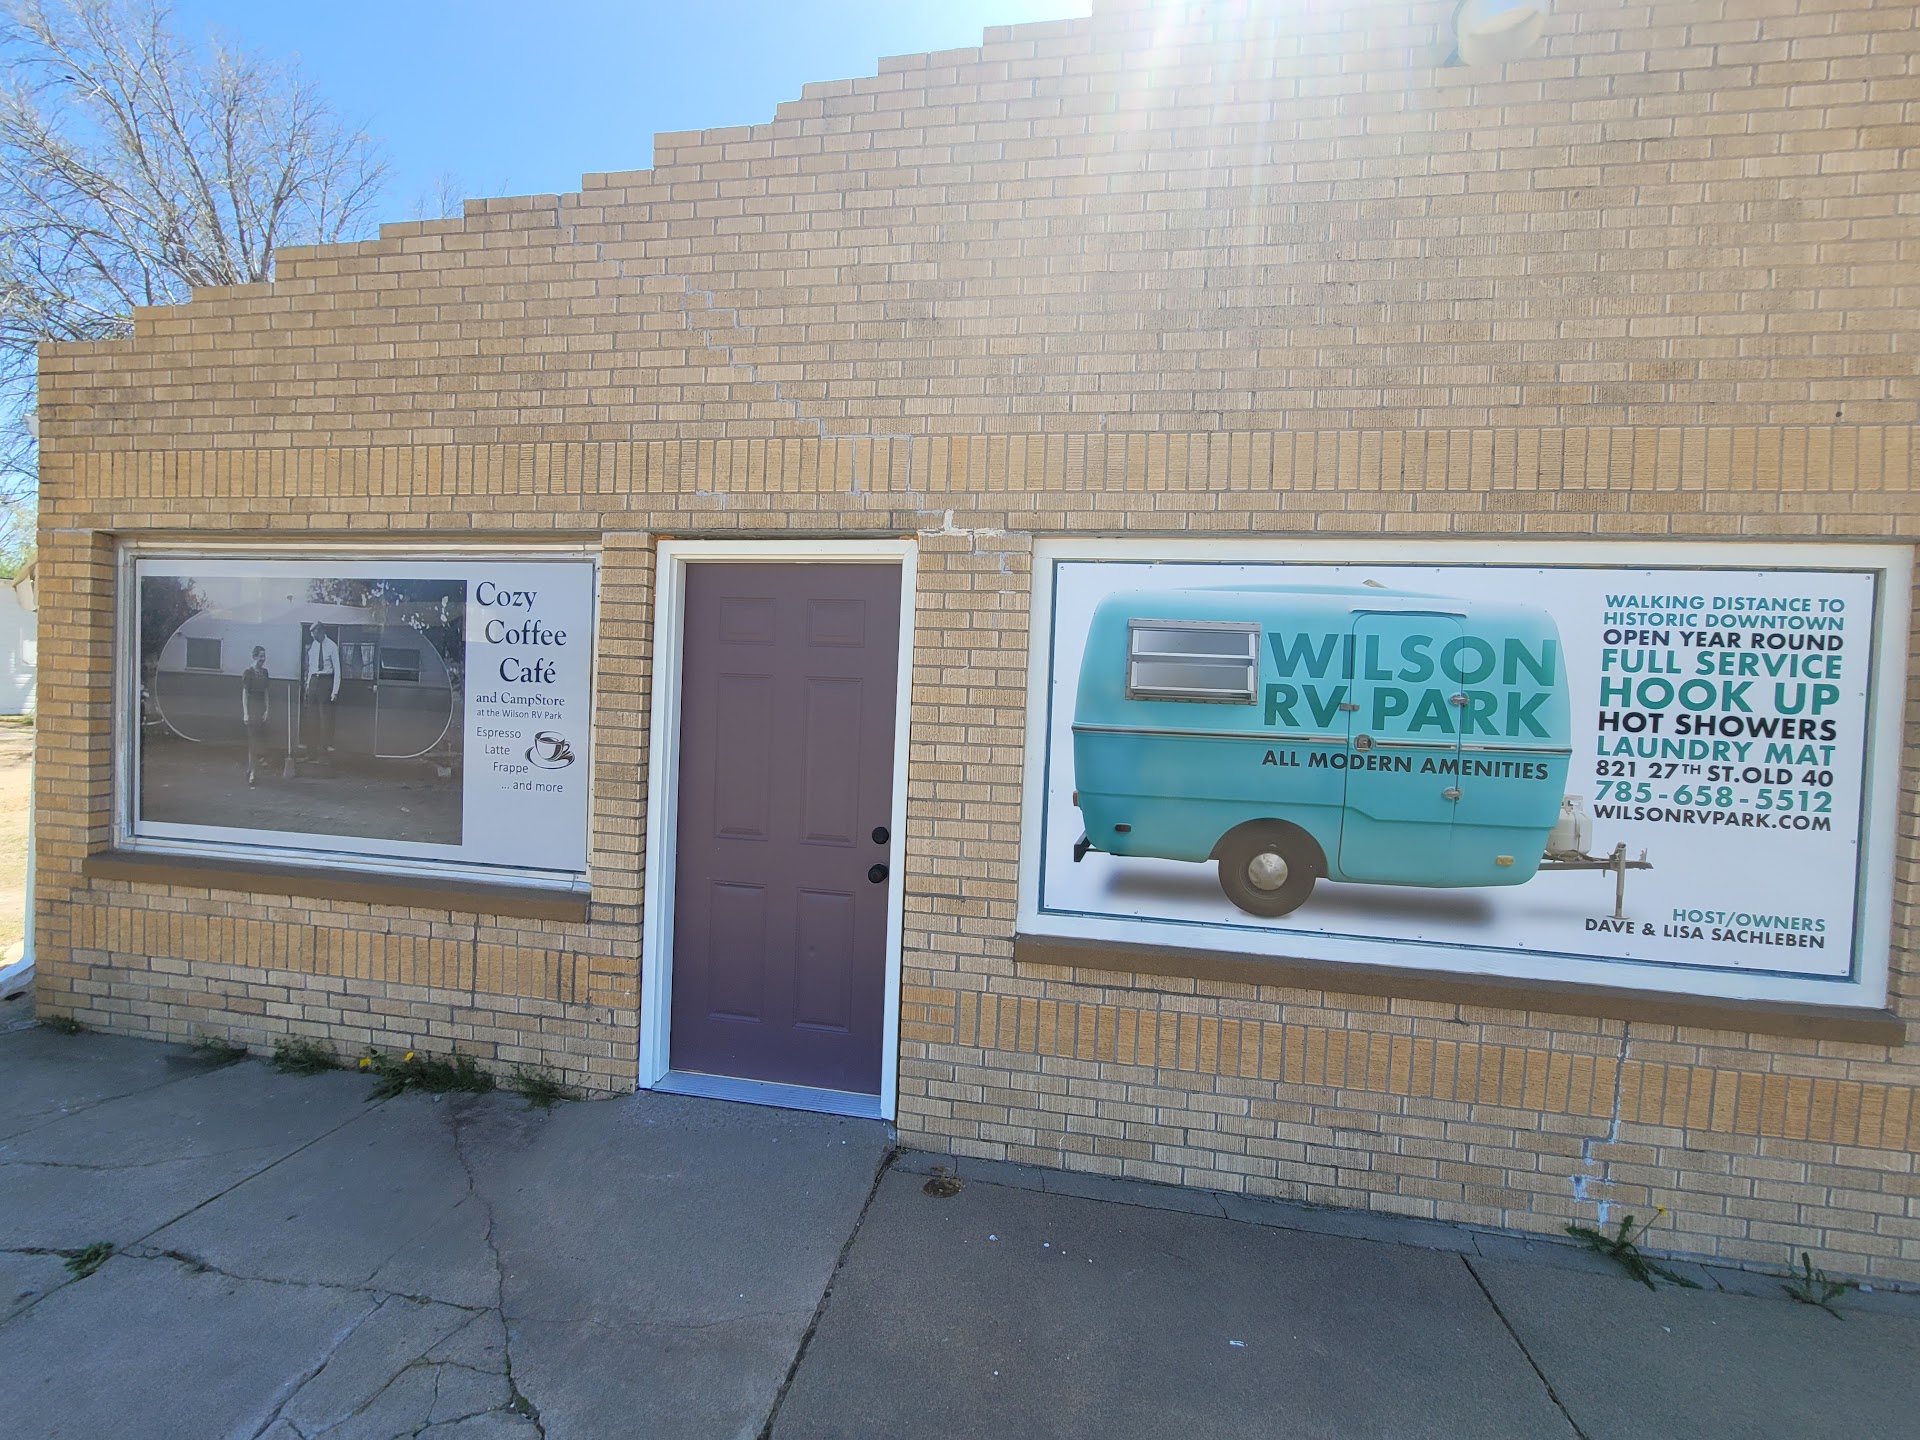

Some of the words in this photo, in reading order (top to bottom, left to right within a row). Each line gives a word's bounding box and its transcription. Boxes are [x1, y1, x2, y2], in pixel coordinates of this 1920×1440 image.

[476, 581, 537, 612] Cozy
[1606, 594, 1705, 610] WALKING
[1713, 596, 1810, 612] DISTANCE
[1818, 599, 1845, 613] TO
[485, 619, 567, 645] Coffee
[1604, 612, 1698, 627] HISTORIC
[1705, 614, 1844, 631] DOWNTOWN
[1603, 629, 1669, 646] OPEN
[1680, 631, 1741, 648] YEAR
[1751, 633, 1843, 650] ROUND
[500, 658, 556, 683] Café
[1268, 632, 1557, 686] WILSON
[1602, 649, 1682, 674] FULL
[1695, 651, 1842, 679] SERVICE
[476, 692, 497, 703] and
[501, 692, 565, 707] CampStore
[1600, 677, 1754, 713] HOOK
[1774, 683, 1839, 715] UP
[487, 709, 500, 717] the
[502, 710, 529, 719] Wilson
[532, 711, 542, 719] RV
[545, 711, 562, 720] Park
[1264, 683, 1348, 728] RV
[1372, 687, 1552, 738] PARK
[476, 727, 521, 741] Espresso
[1599, 711, 1664, 733] HOT
[1675, 714, 1837, 741] SHOWERS
[485, 744, 510, 755] Latte
[1597, 735, 1753, 763] LAUNDRY
[1764, 743, 1836, 766] MAT
[493, 762, 528, 775] Frappe
[1262, 750, 1300, 766] ALL
[1308, 752, 1412, 772] MODERN
[1420, 758, 1548, 780] AMENITIES
[1596, 760, 1636, 777] 821
[1802, 769, 1833, 787] 40
[513, 780, 532, 791] and
[535, 783, 563, 792] more
[1593, 804, 1831, 831] WILSONRVPARK.COM
[1585, 918, 1635, 934] DAVE
[1642, 923, 1656, 936] &
[1663, 925, 1703, 940] LISA
[1711, 928, 1825, 949] SACHLEBEN
[1673, 909, 1825, 932] HOST/OWNERS
